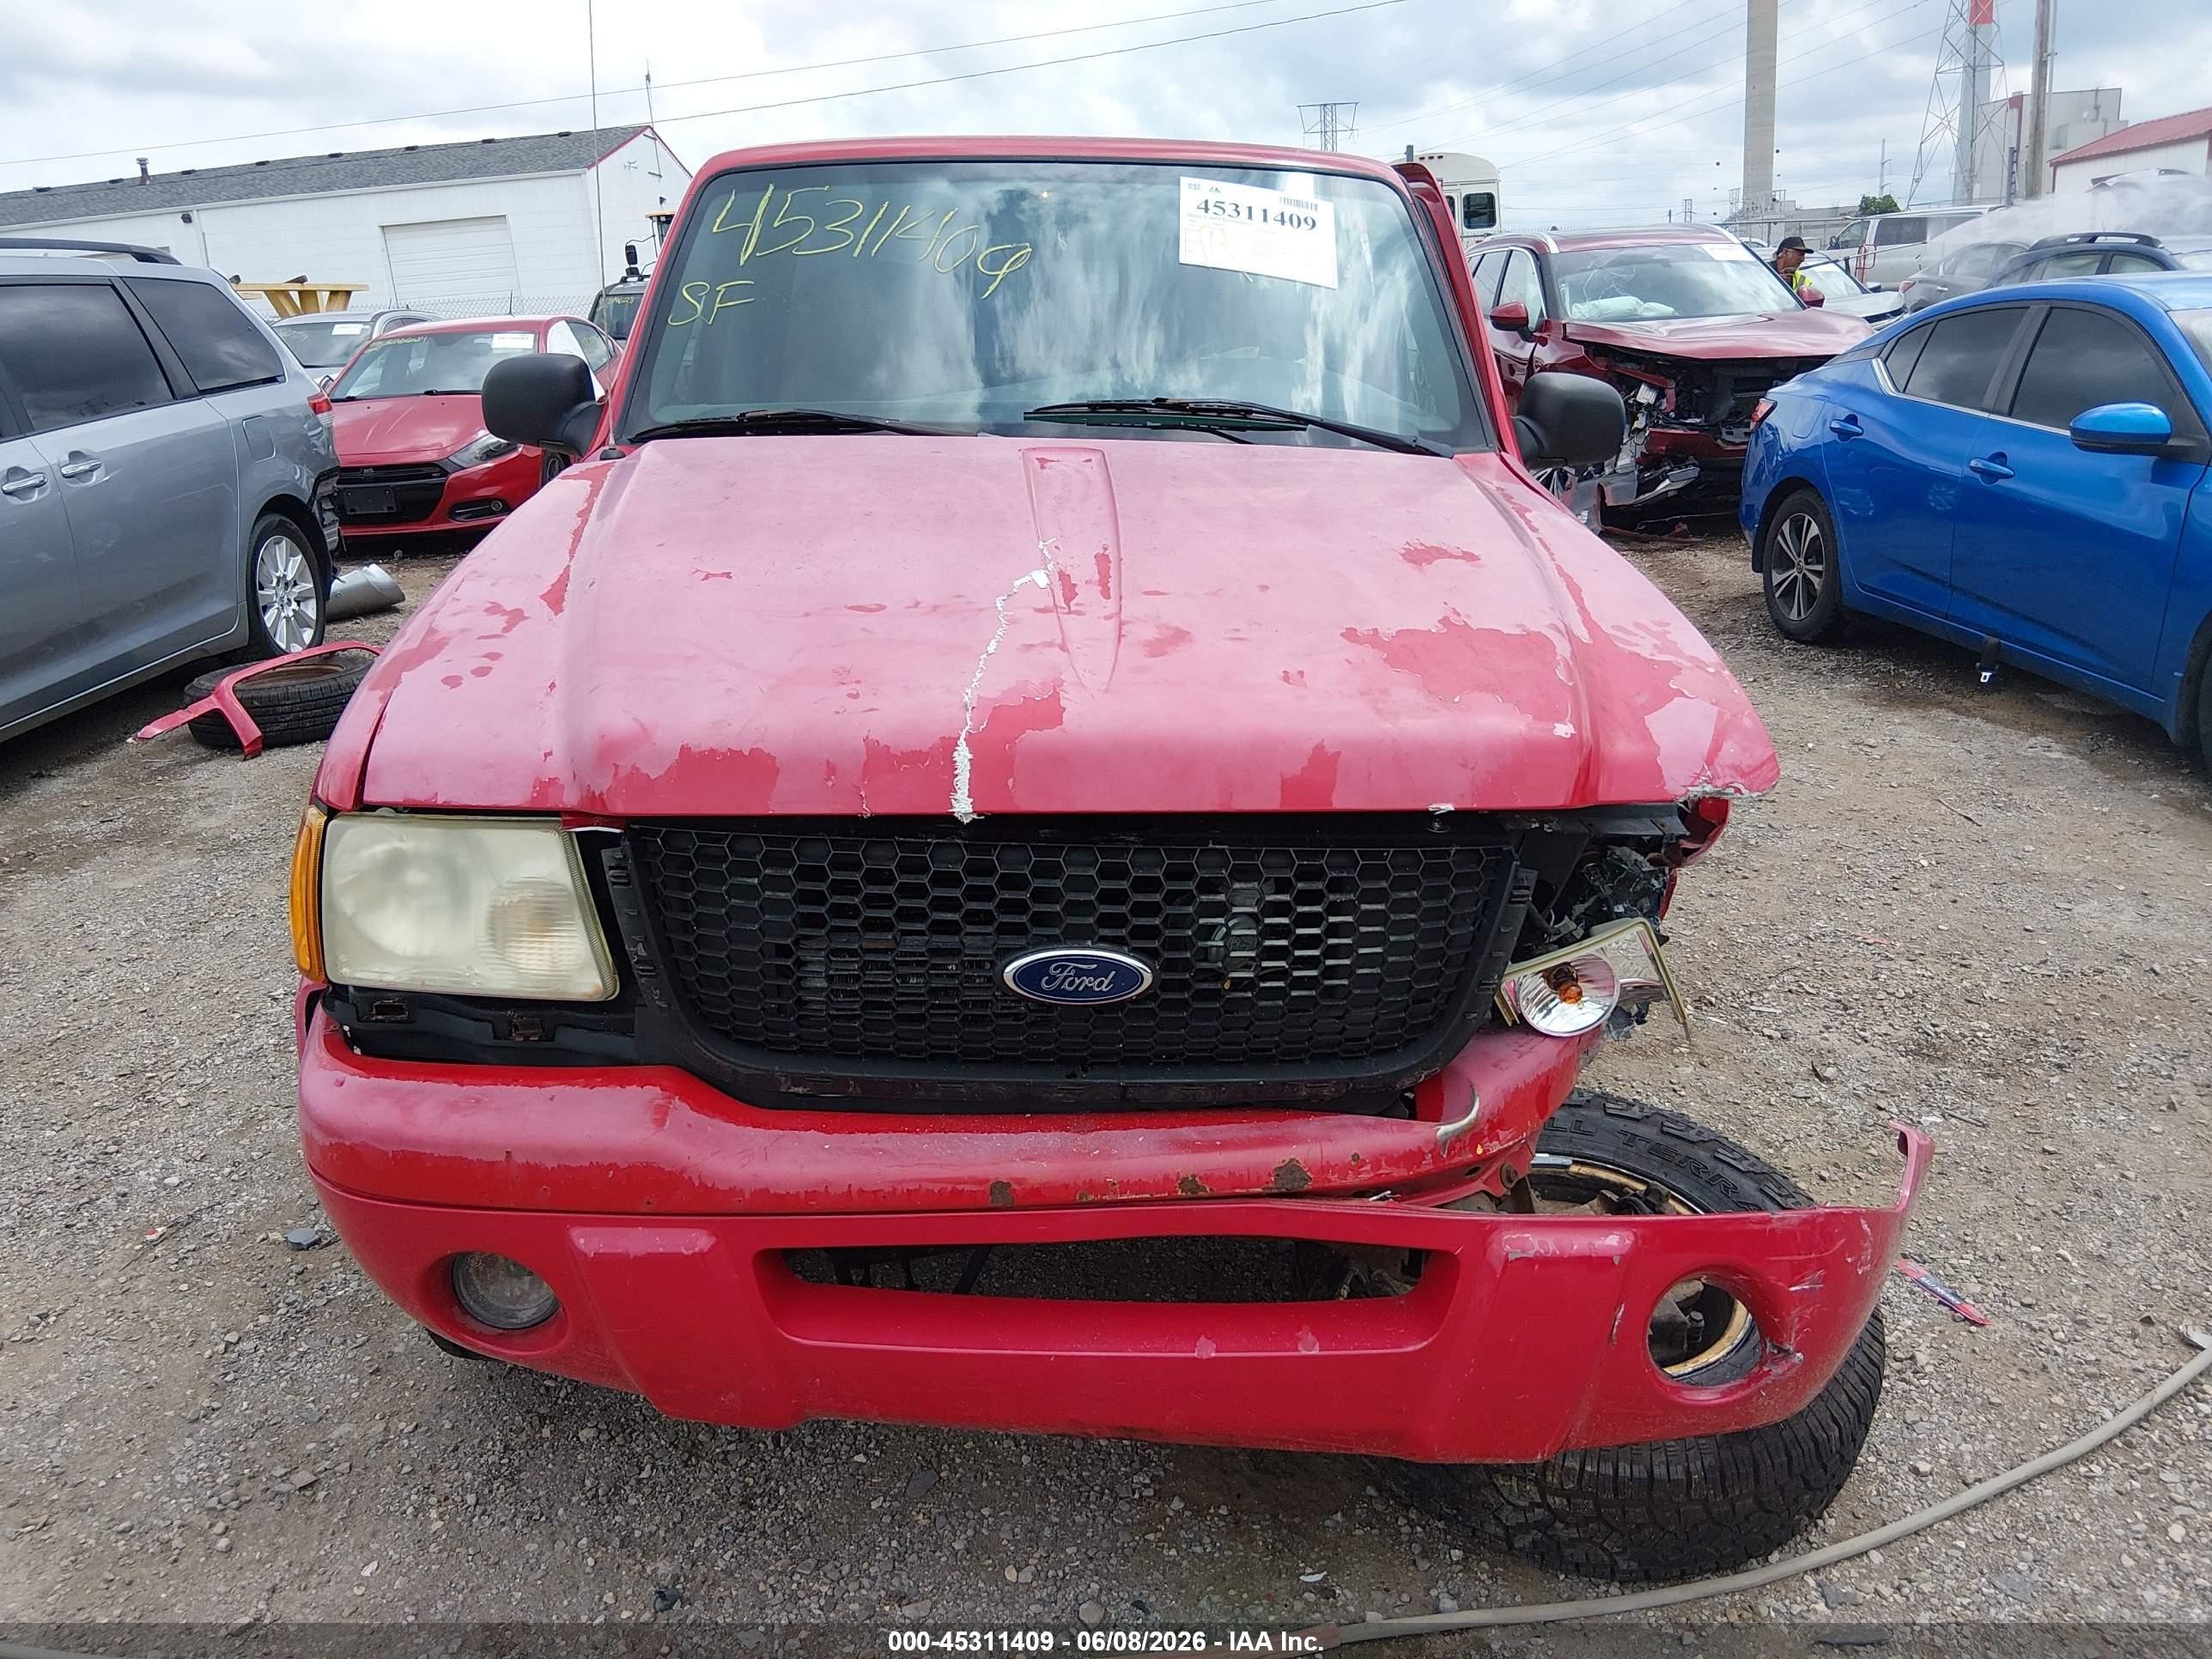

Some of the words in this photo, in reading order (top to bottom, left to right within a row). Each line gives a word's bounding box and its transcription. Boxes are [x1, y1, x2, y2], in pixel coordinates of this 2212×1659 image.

[1196, 198, 1316, 231] 45311409
[712, 183, 1032, 299] 45311409
[667, 281, 756, 325] SF
[1041, 962, 1116, 992] Ford
